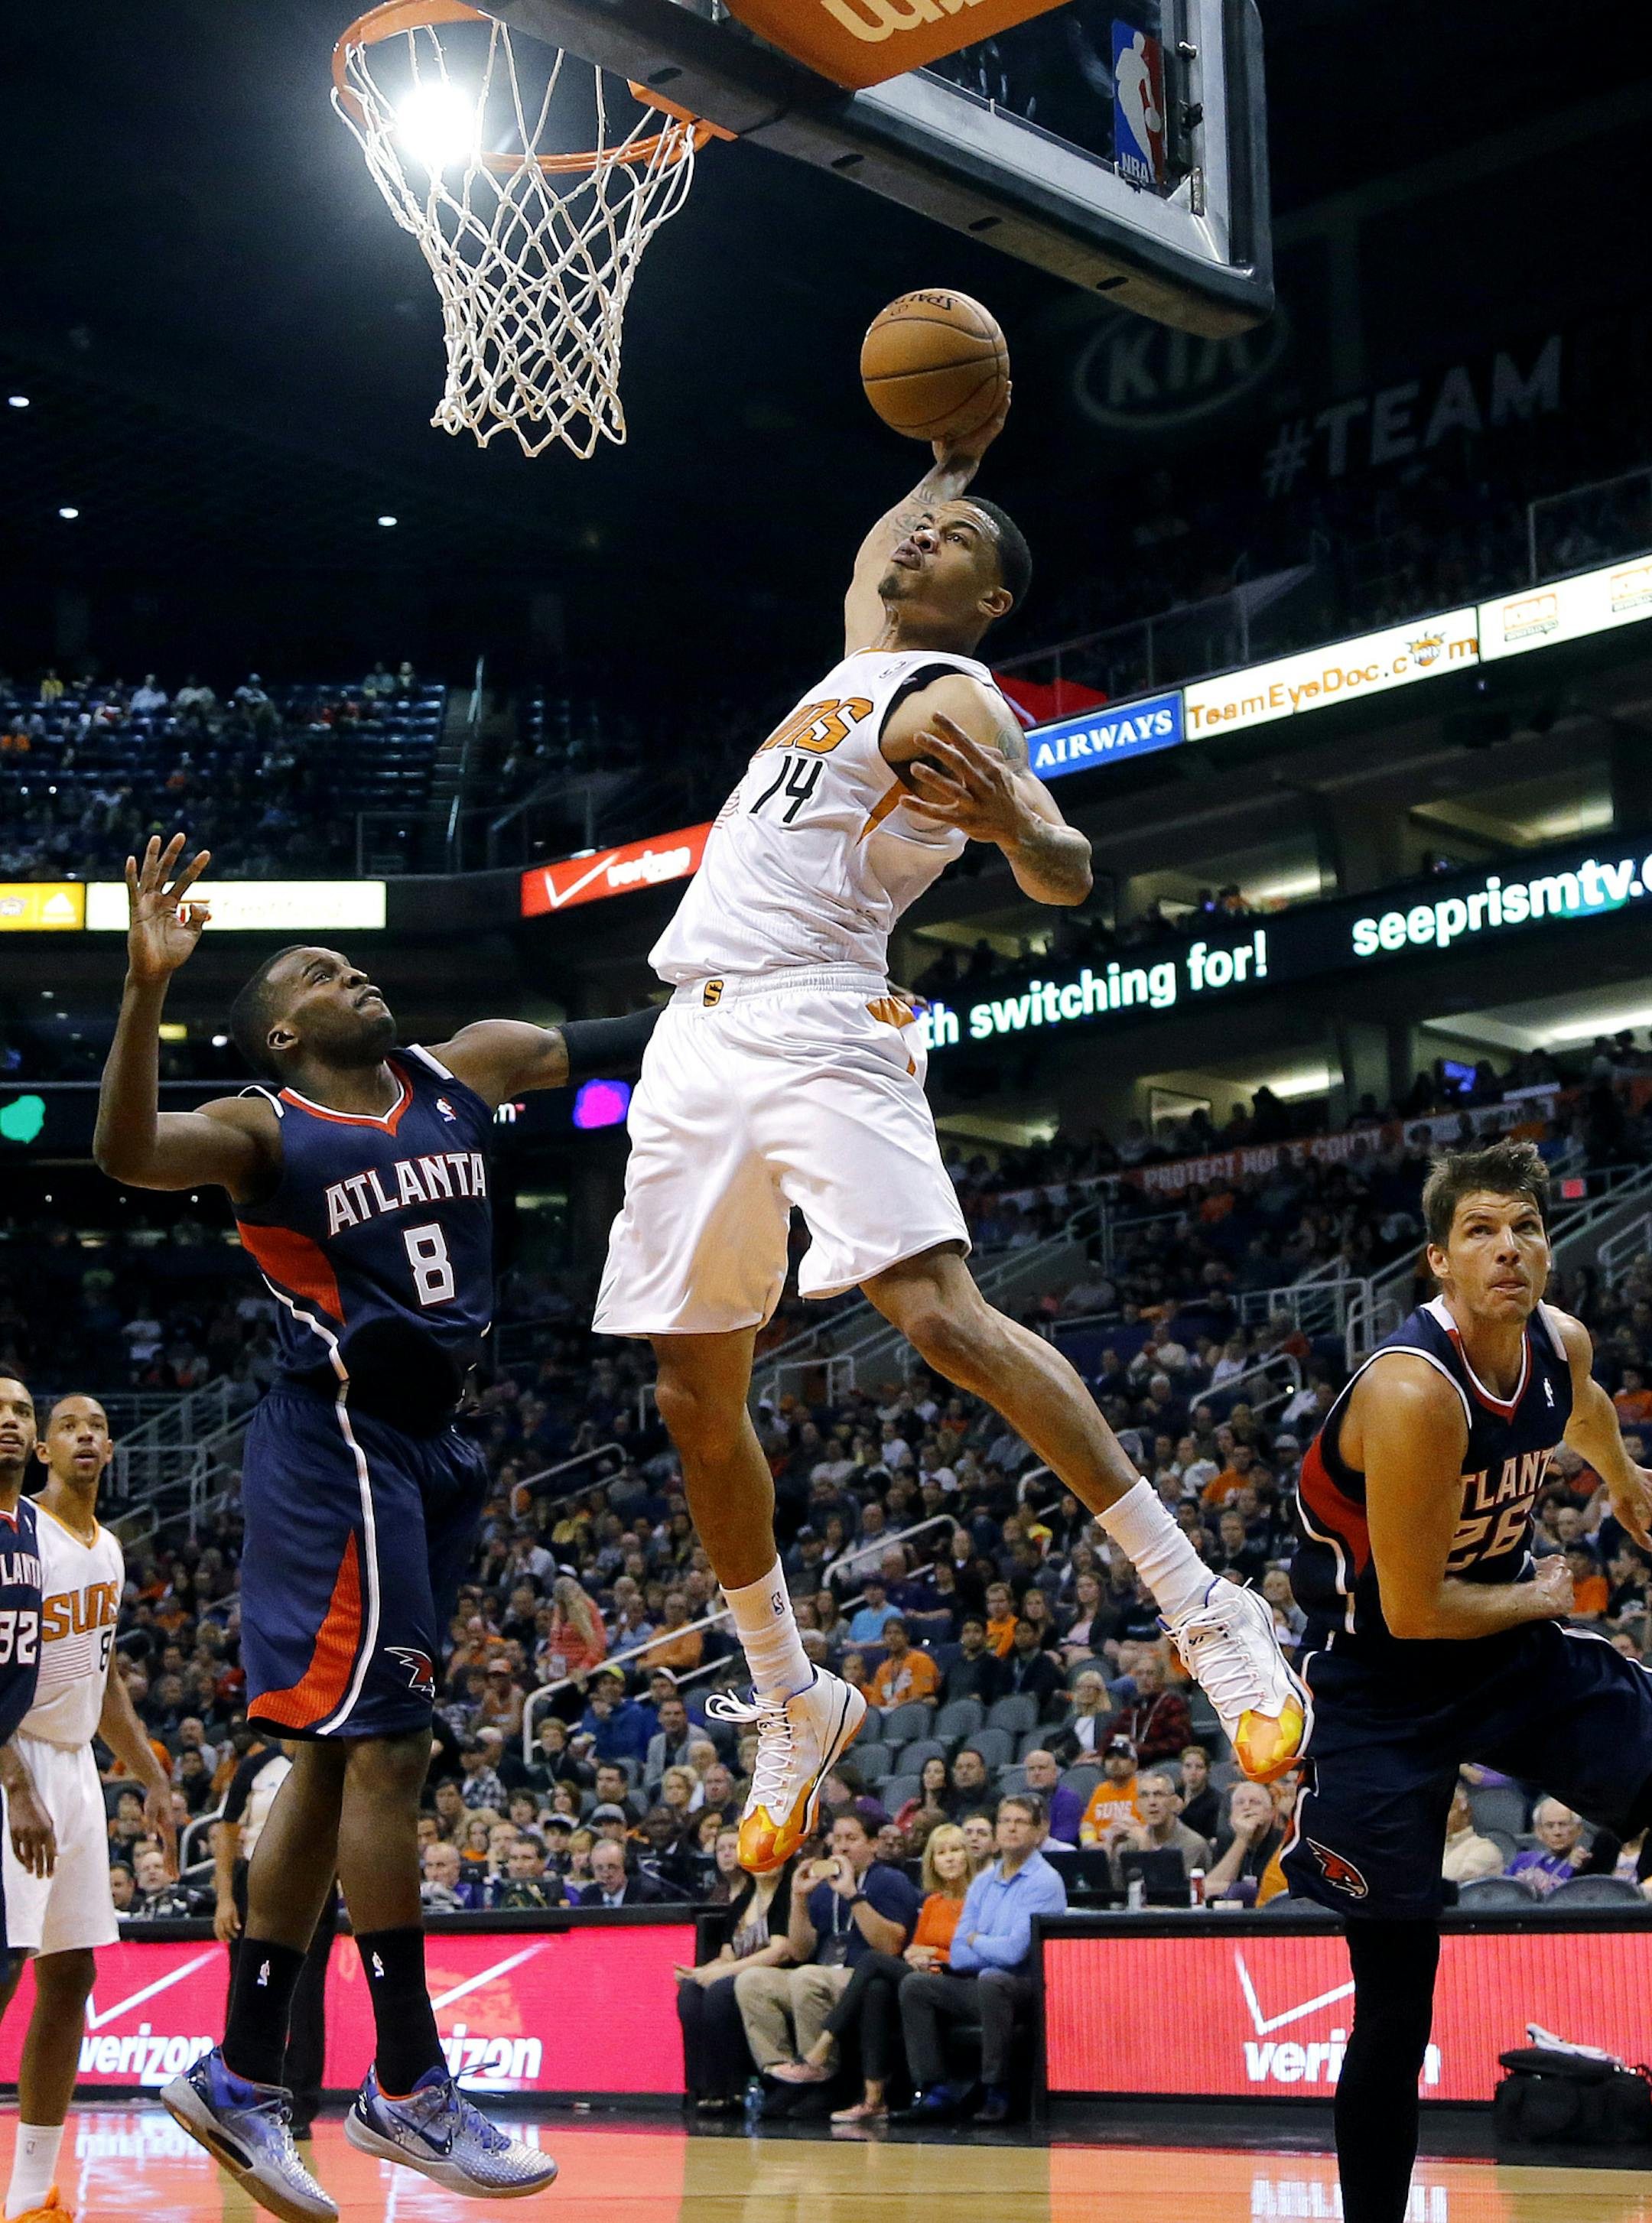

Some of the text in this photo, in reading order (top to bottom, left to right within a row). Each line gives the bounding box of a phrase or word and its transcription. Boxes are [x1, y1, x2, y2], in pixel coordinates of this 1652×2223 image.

[1261, 333, 1563, 499] #TEAM
[1036, 709, 1173, 769] AIRWAYS
[750, 754, 824, 824] 14
[969, 962, 1176, 1040] switching
[1187, 929, 1268, 991] for!
[324, 1151, 487, 1237] ATLANTA
[402, 1221, 456, 1307] 8
[78, 2022, 215, 2087] verizon
